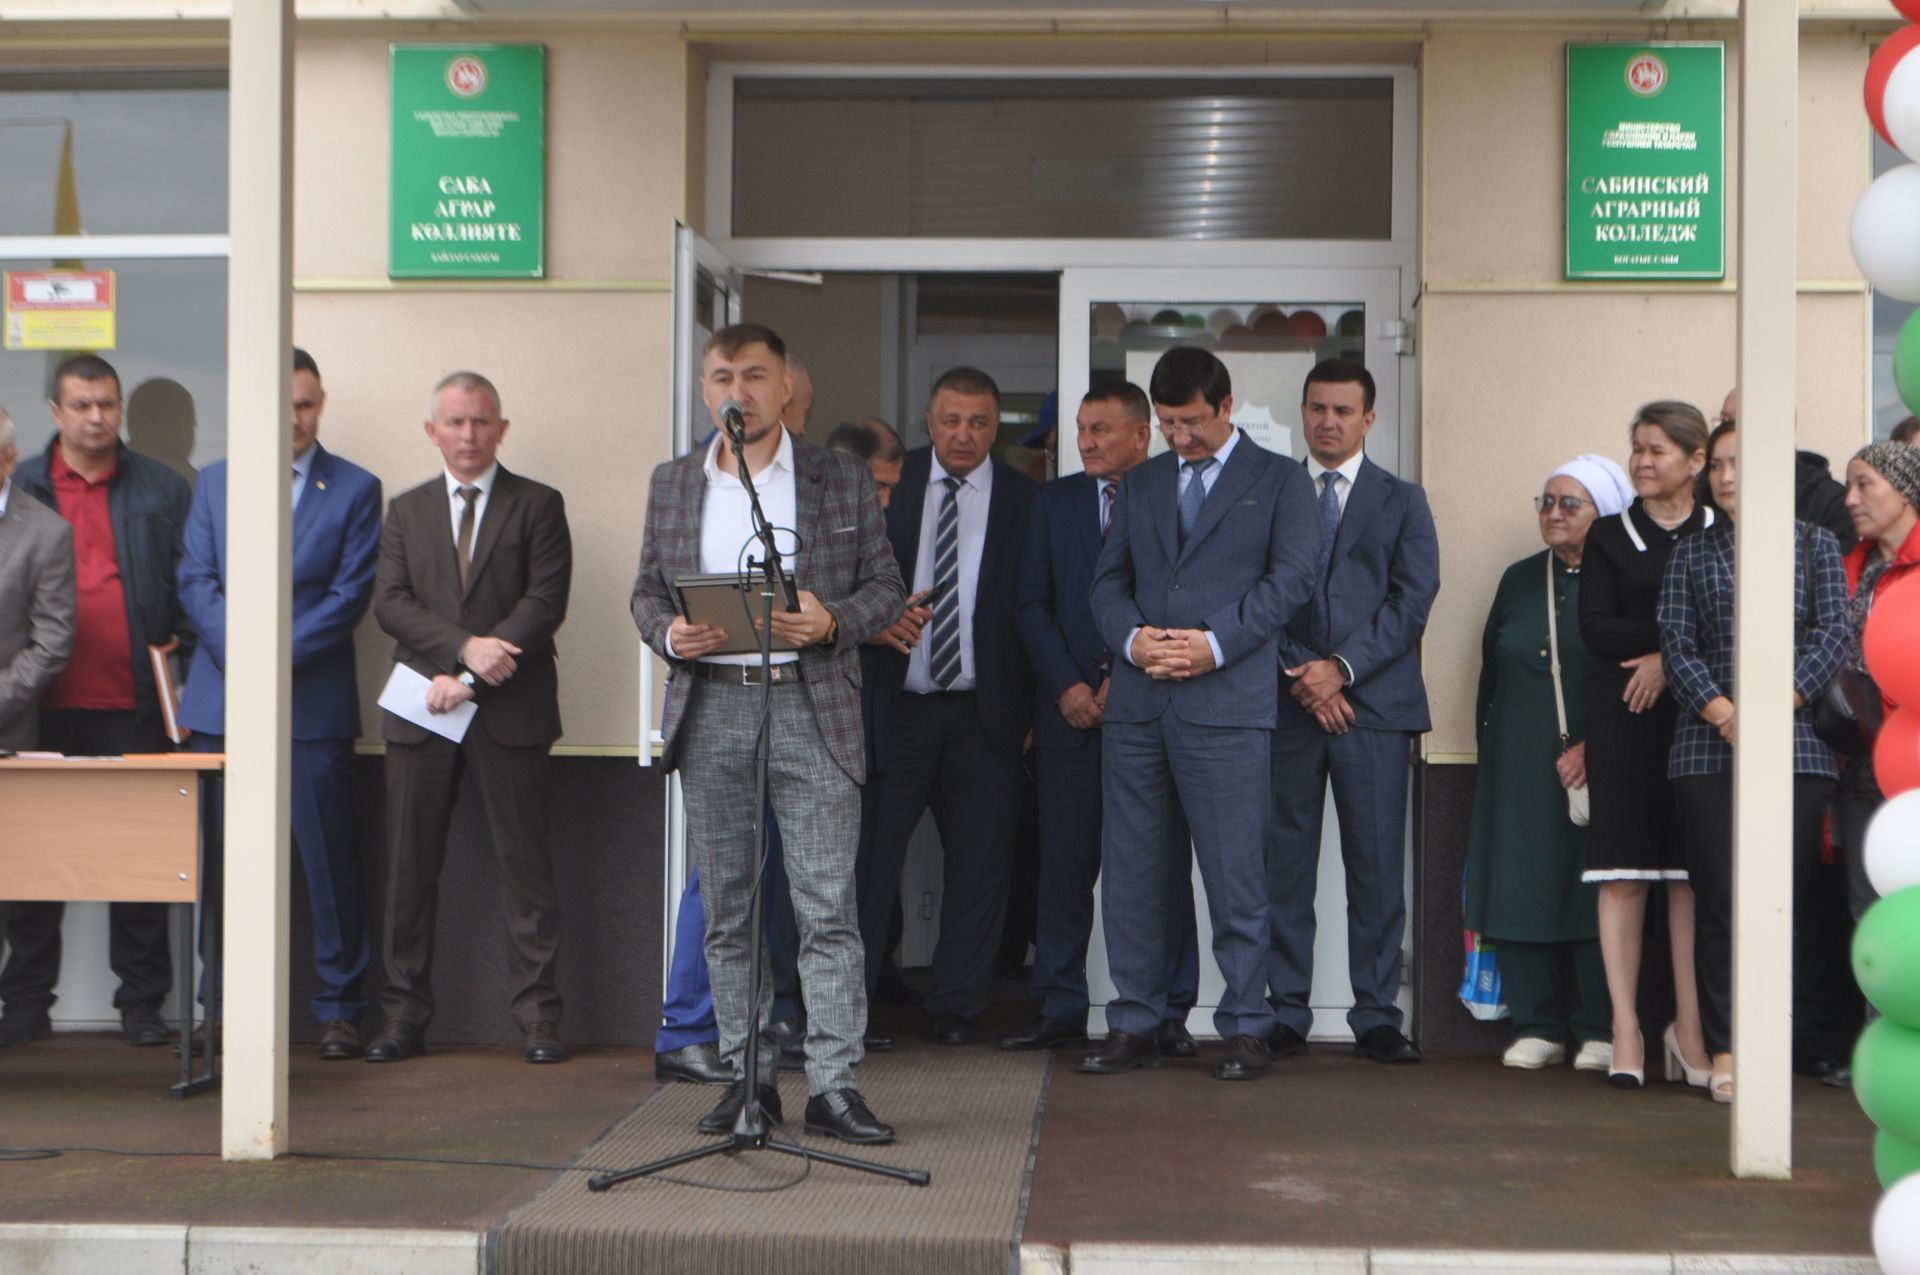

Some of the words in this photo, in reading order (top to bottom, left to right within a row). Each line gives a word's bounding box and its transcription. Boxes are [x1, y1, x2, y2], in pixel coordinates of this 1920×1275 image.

[1582, 172, 1709, 194] САБИНСКИЙ
[434, 199, 496, 218] АГРАР
[1591, 197, 1700, 218] АГРАРНЫЙ
[1595, 224, 1697, 244] КОЛЛЕДЖ
